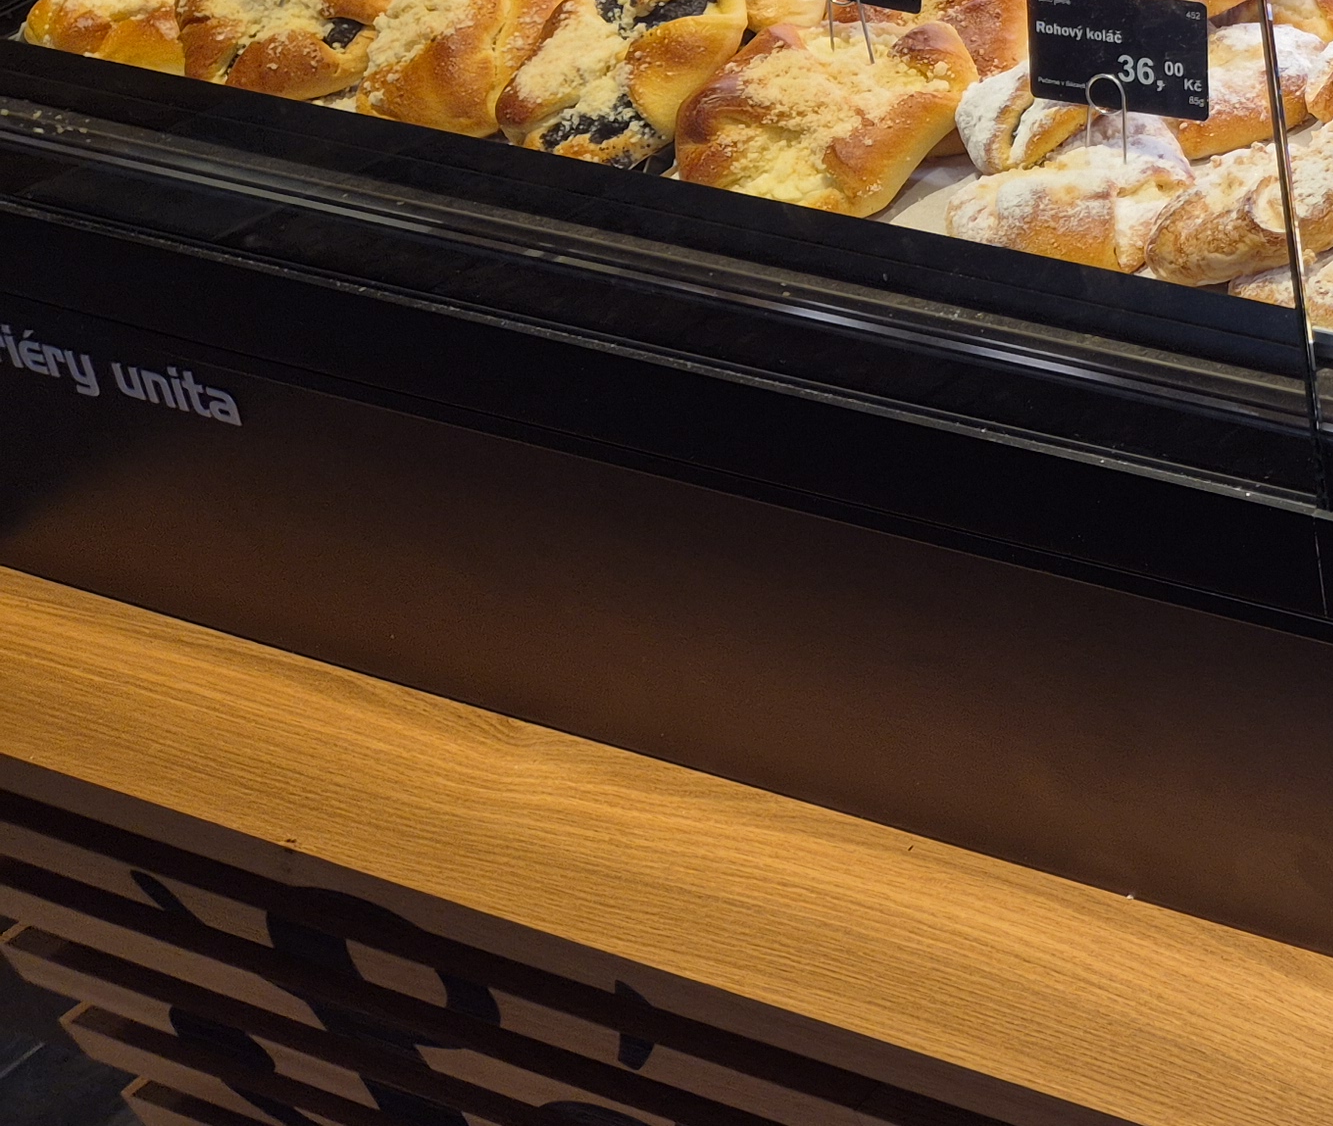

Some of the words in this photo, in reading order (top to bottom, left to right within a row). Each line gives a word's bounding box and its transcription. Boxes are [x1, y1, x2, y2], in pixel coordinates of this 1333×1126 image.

[1186, 11, 1200, 20] 452
[1036, 21, 1083, 41] Rohový
[1086, 27, 1123, 44] koláč
[1117, 54, 1184, 92] 36,00
[1183, 79, 1202, 92] Kč
[111, 361, 243, 426] unita
